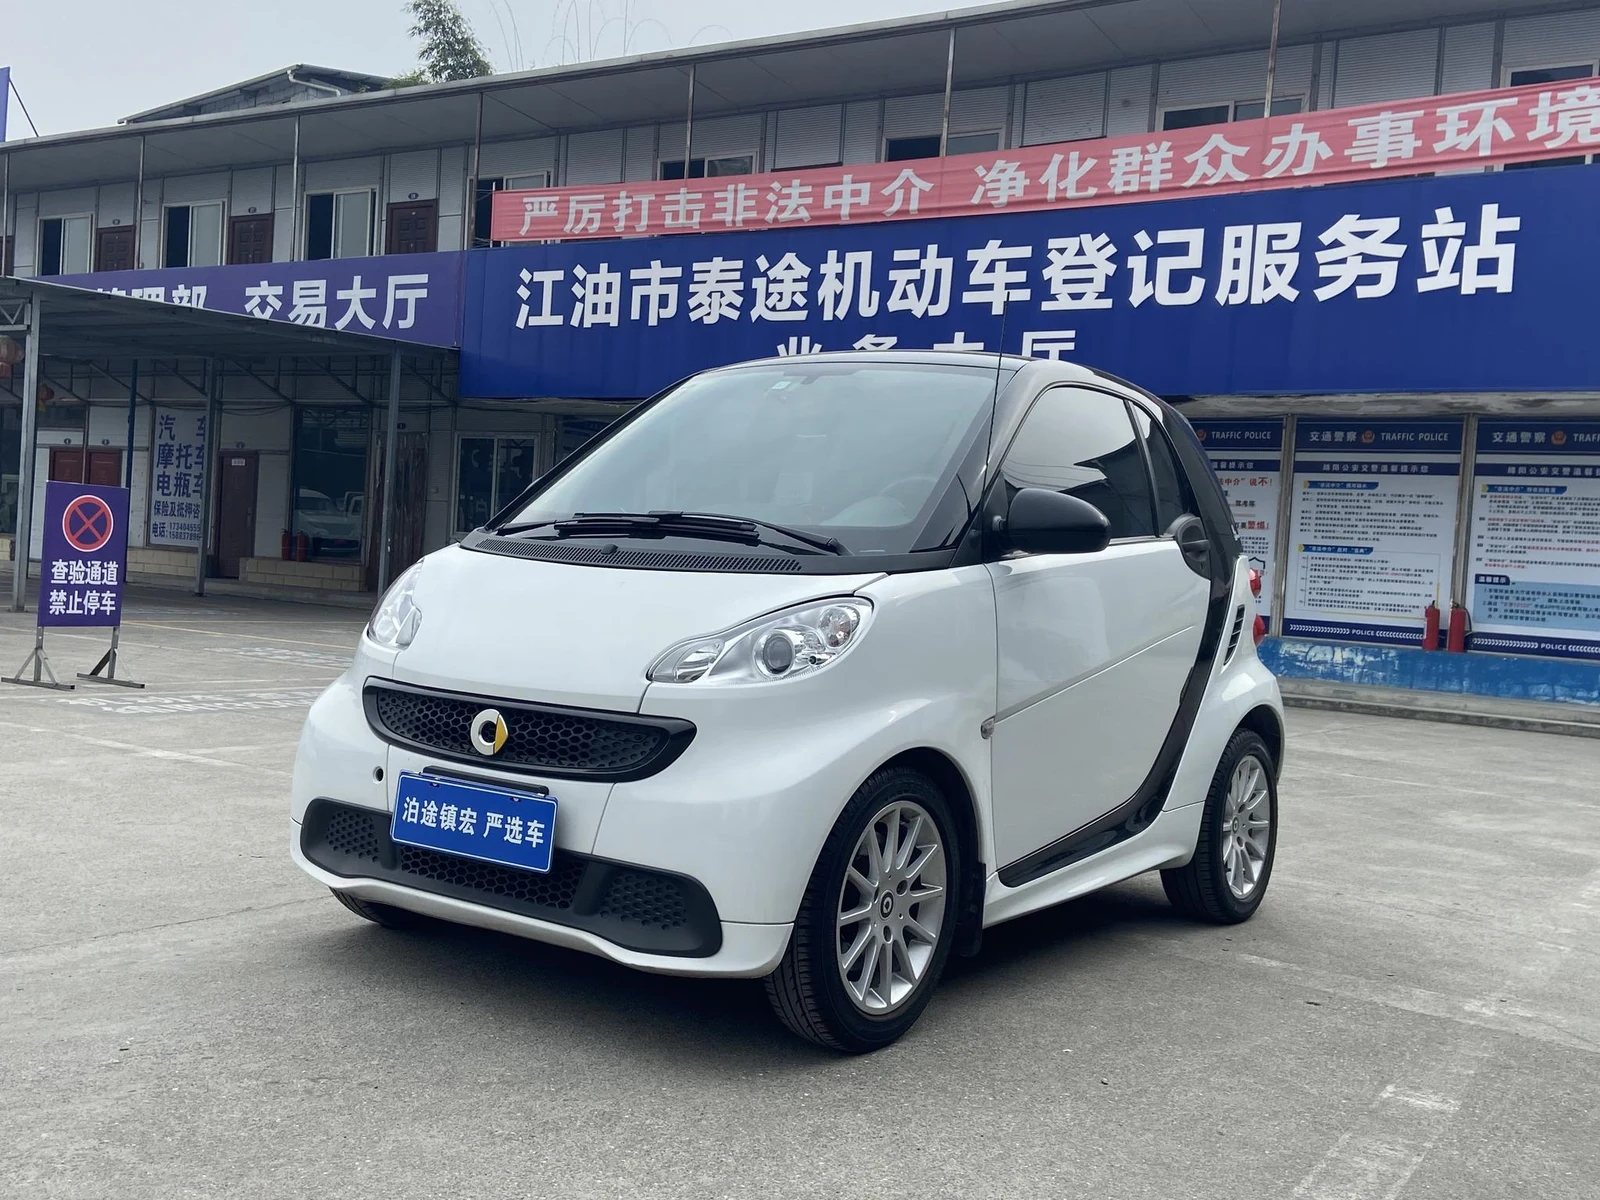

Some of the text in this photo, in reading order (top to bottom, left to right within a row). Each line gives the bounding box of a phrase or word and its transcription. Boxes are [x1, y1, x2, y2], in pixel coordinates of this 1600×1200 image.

[518, 85, 1600, 236] 严厉打击非法中介 净化群众办事环境
[515, 203, 1521, 329] 江油市泰途机动车登记服务站
[244, 273, 429, 330] 交易大厅
[1211, 431, 1271, 439] TRAFFIC POLICE
[1309, 431, 1357, 442] 交通警察
[1381, 432, 1449, 441] TRAFFIC POLICE
[1492, 431, 1546, 443] 交通警察
[51, 559, 119, 585] 查验通道
[49, 589, 117, 616] 禁止停车
[1540, 643, 1567, 651] POLICE
[402, 796, 545, 848] 泊途镇宏 严选车
